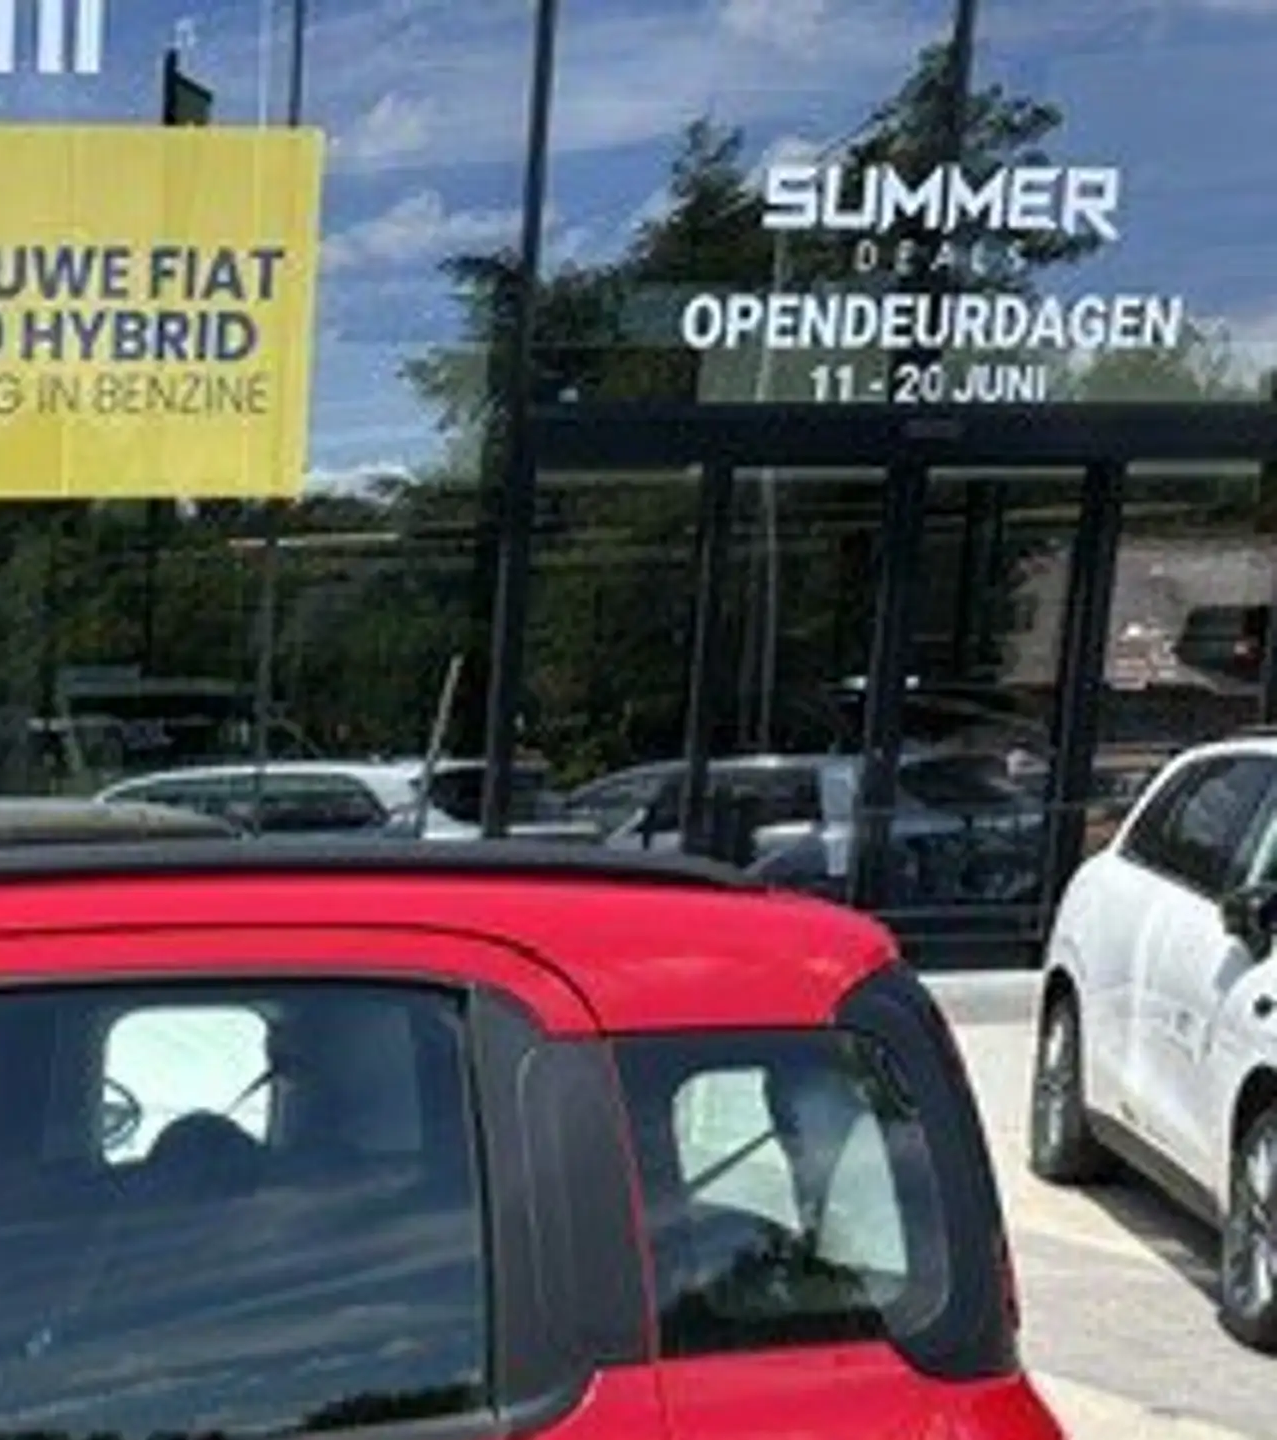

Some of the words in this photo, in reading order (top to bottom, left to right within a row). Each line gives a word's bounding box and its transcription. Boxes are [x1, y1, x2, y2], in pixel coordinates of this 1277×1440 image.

[762, 165, 1119, 239] SUMMER
[150, 247, 286, 300] FIAT
[854, 243, 1026, 273] DEALS
[20, 311, 259, 362] HYBRID
[683, 294, 1182, 350] OPENDEURDAGEN
[37, 373, 79, 415] IN
[93, 373, 269, 415] BENZINE
[810, 364, 854, 403] 11
[893, 364, 943, 403] 20
[951, 364, 1047, 403] JUNI
